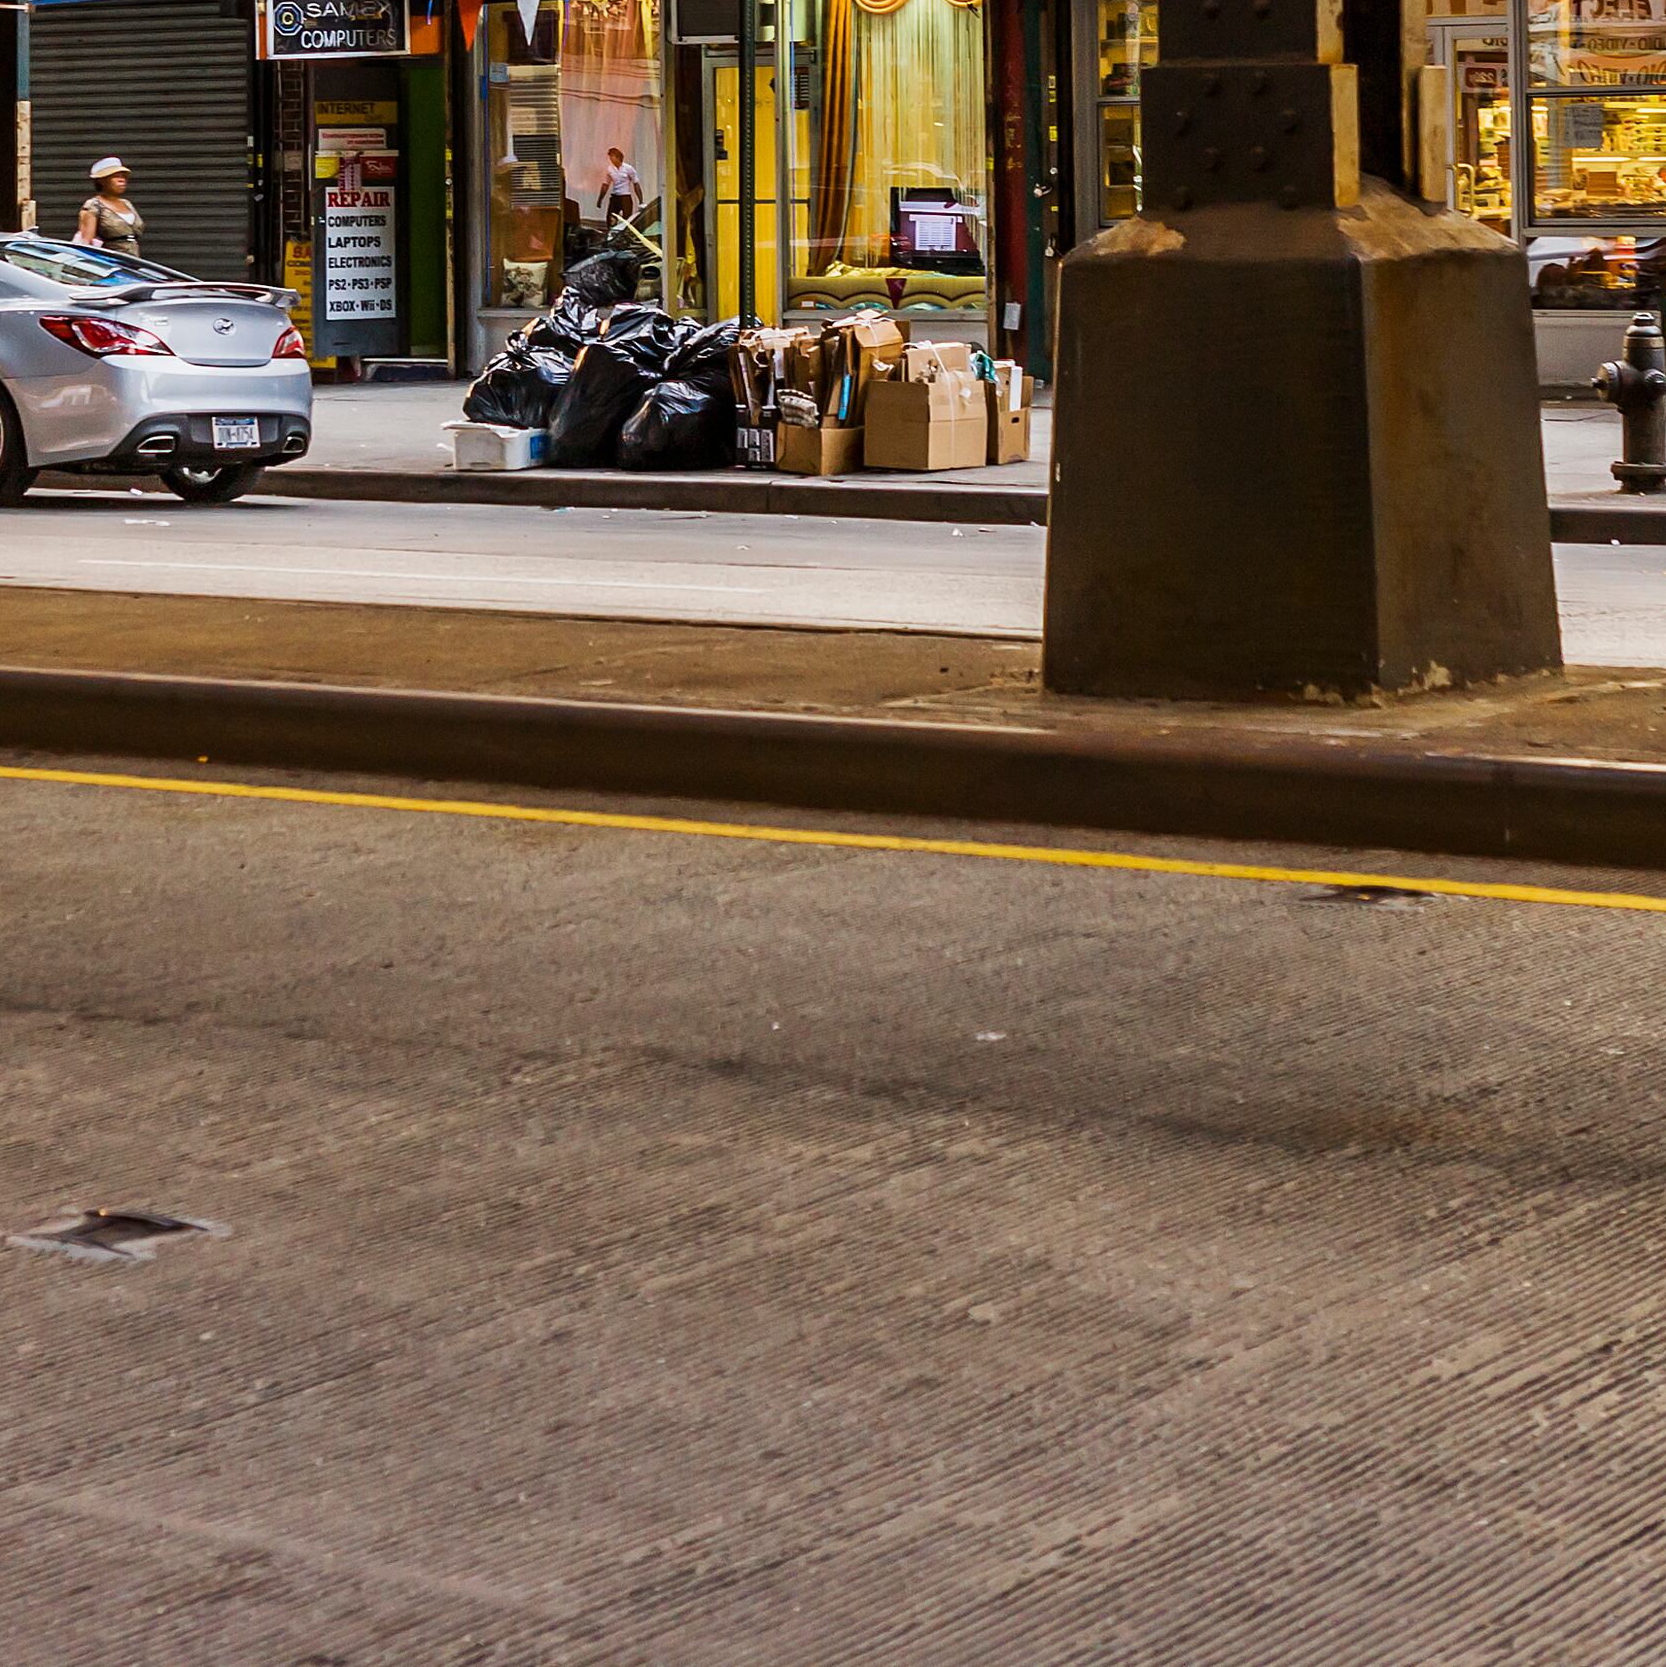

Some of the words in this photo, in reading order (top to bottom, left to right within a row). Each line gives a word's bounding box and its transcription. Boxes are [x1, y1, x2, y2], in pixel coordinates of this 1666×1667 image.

[300, 29, 398, 48] COMPUTERS
[317, 102, 375, 116] INTERNET
[327, 191, 390, 208] REPAIR
[328, 215, 386, 228] COMPUTERS
[328, 236, 382, 249] LAPTOPS
[328, 255, 392, 269] ELECTRONICS
